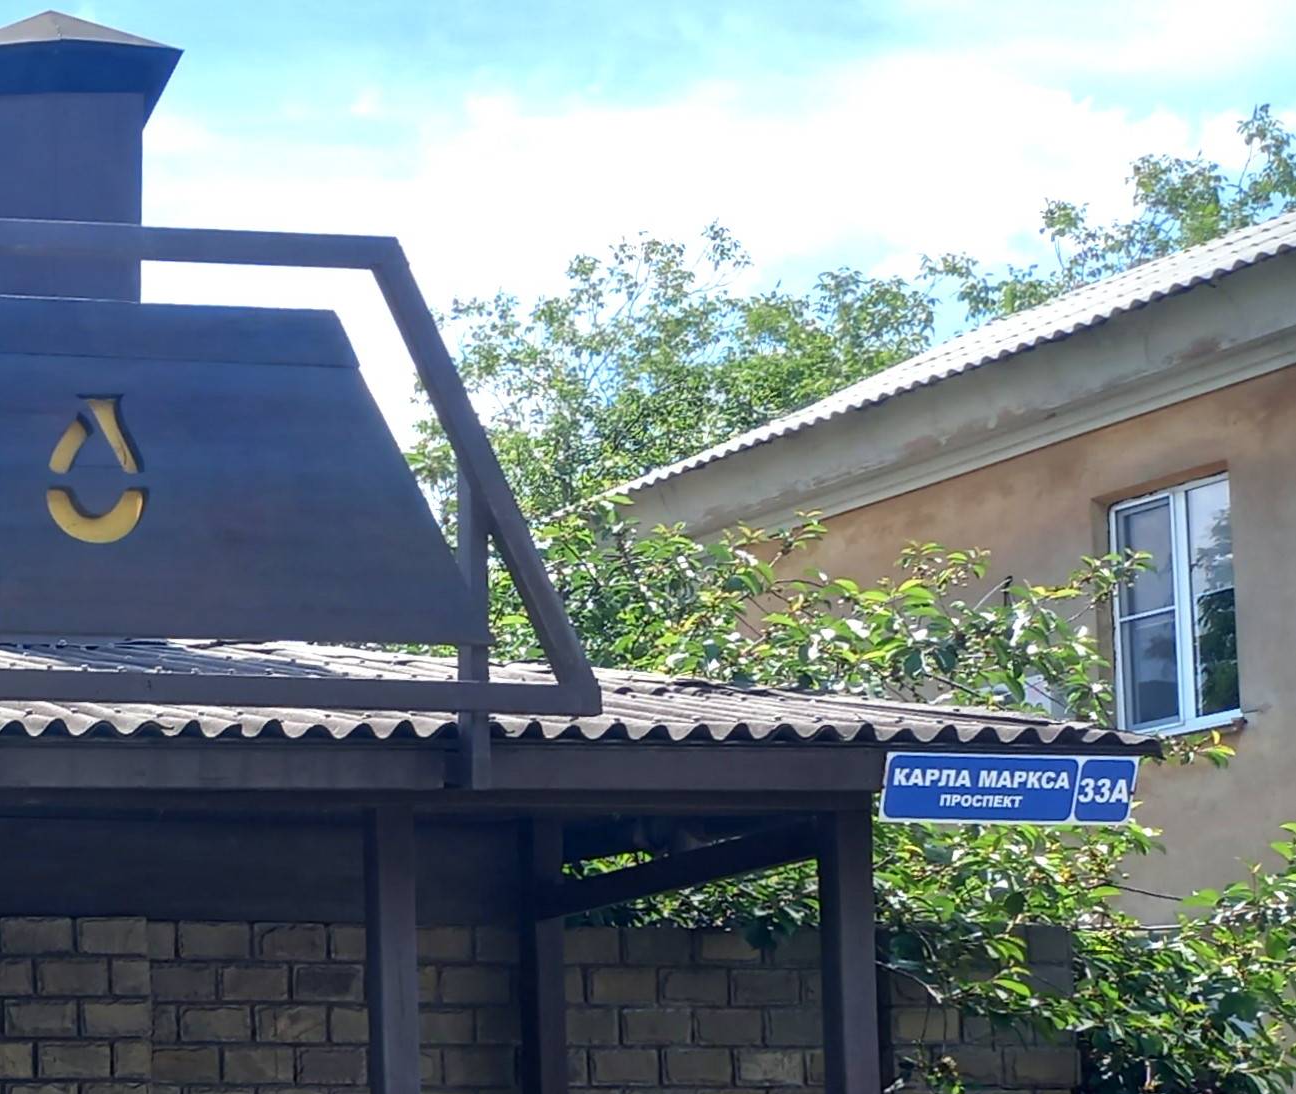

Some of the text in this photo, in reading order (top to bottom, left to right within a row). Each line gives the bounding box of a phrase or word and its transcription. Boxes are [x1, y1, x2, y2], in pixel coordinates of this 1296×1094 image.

[893, 768, 1070, 790] КАРЛА МАРКСА
[939, 793, 1023, 809] ПРОСПЕКТ
[1078, 778, 1129, 804] 33А
